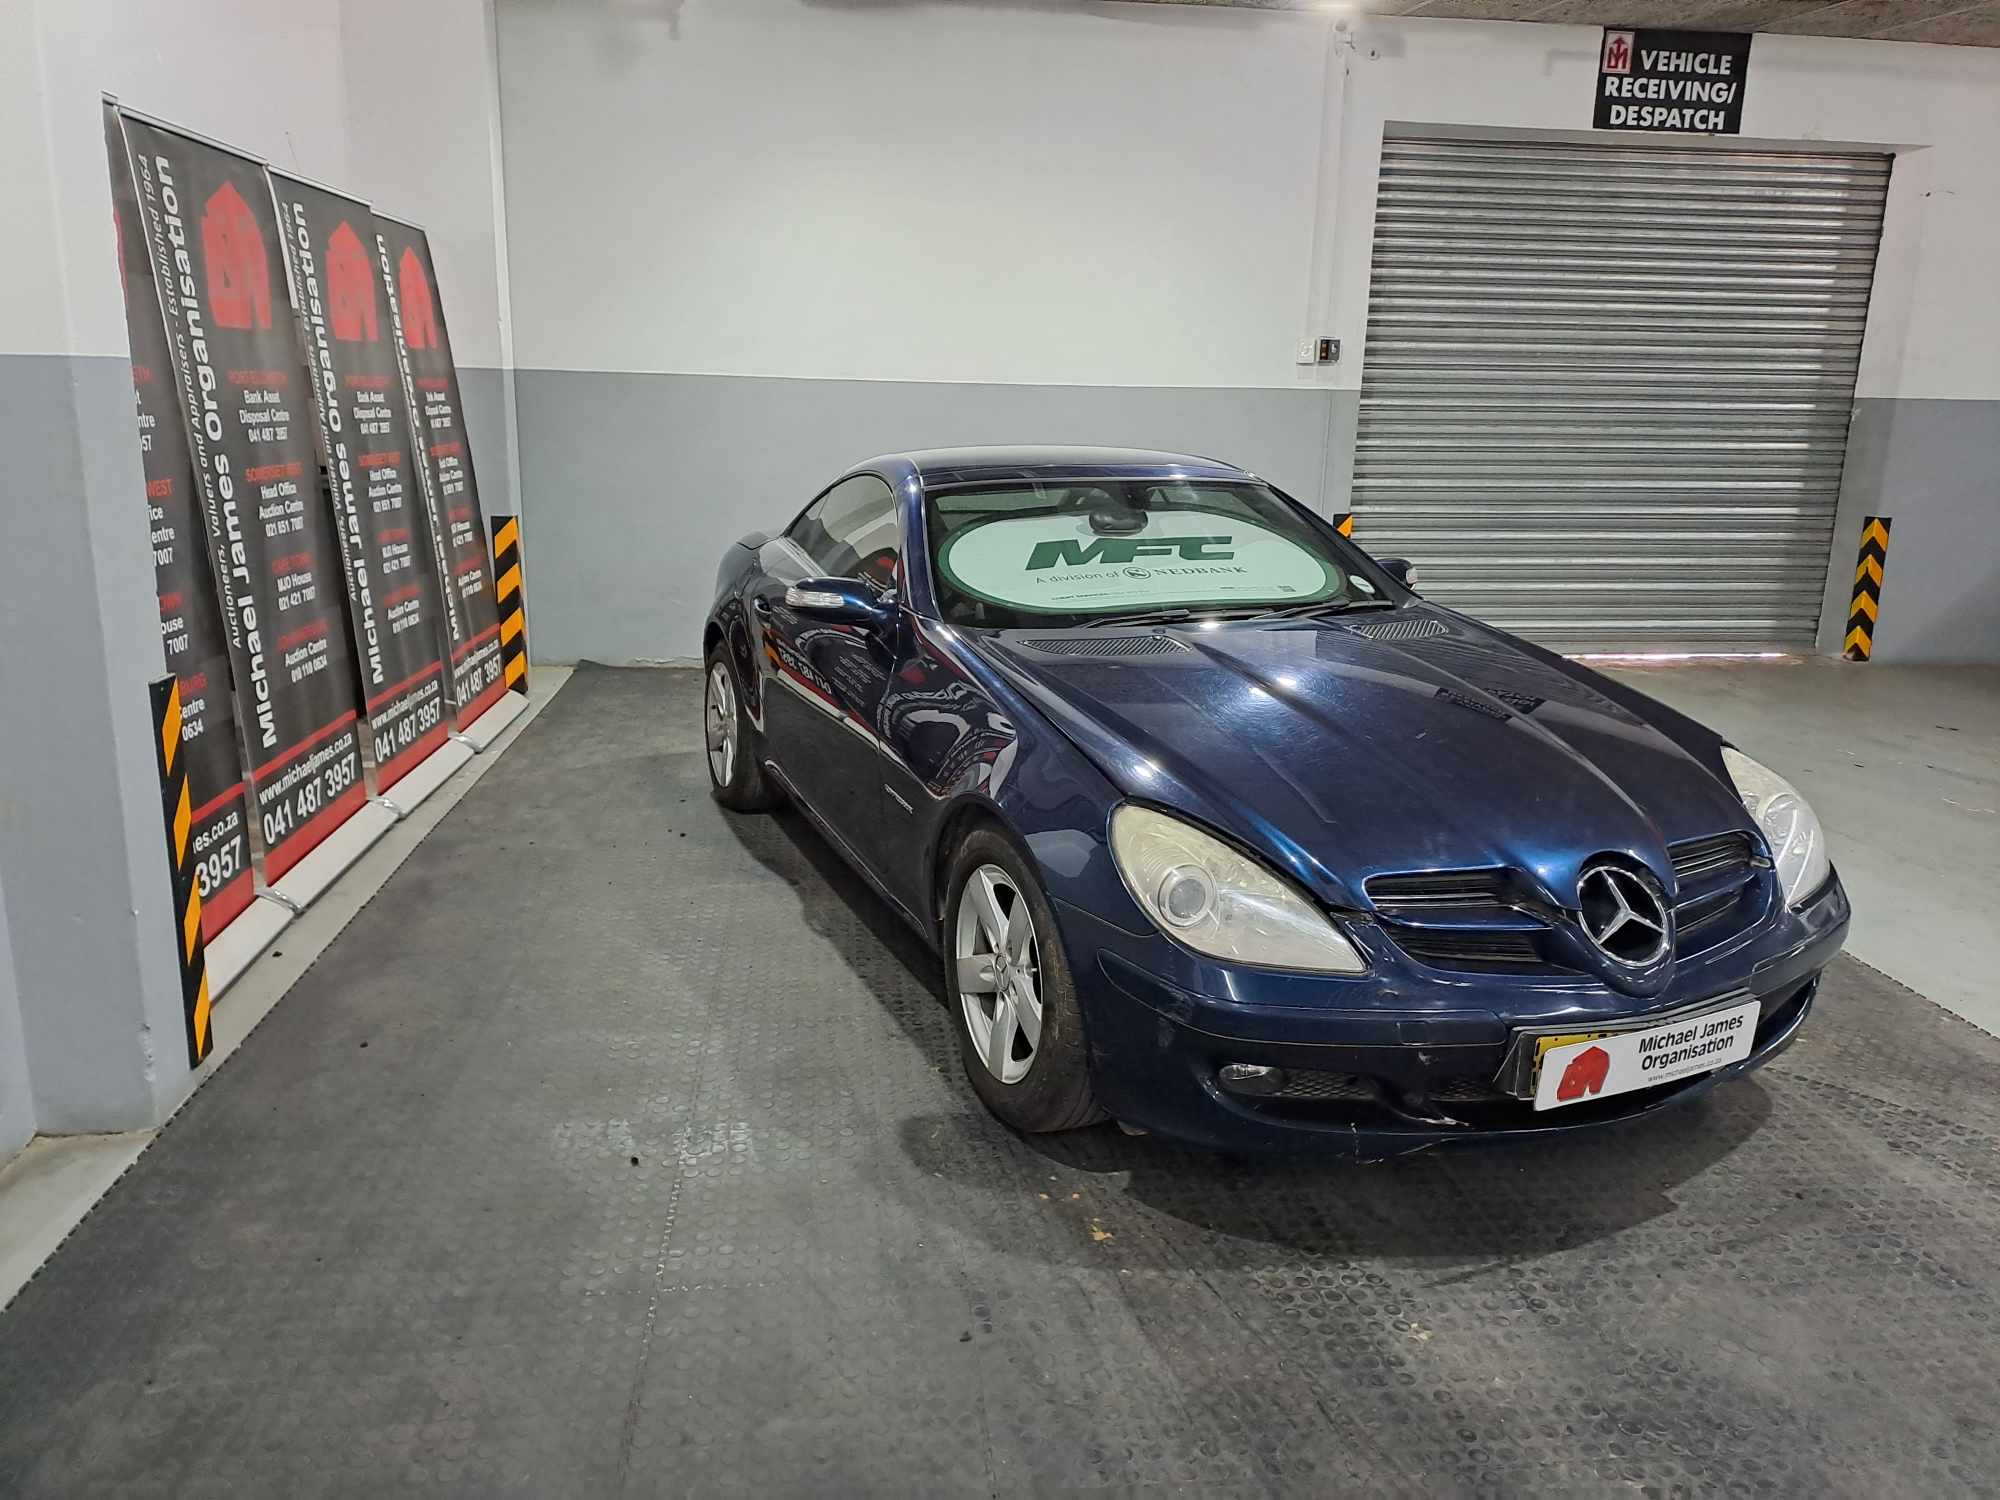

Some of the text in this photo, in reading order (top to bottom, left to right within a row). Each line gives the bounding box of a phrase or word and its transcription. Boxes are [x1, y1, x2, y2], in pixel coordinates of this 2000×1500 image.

[1641, 50, 1732, 75] VEHICLE
[1605, 76, 1737, 104] RECEIVING/
[1610, 105, 1725, 130] DESPATCH
[138, 154, 156, 201] 1964
[148, 206, 178, 316] Established
[293, 203, 341, 433] Organisation
[176, 333, 202, 429] Appraisers
[155, 156, 277, 749] Michael James Organisation
[193, 433, 208, 468] and
[203, 472, 221, 537] Valuers
[335, 443, 362, 549] James
[151, 527, 175, 543] entre
[1025, 536, 1234, 570] MFC
[1049, 573, 1103, 583] division
[1105, 570, 1120, 579] of
[1154, 566, 1248, 577] NEDBANK
[161, 617, 184, 634] ouse
[167, 634, 188, 655] 7007
[354, 558, 384, 685] Michael
[456, 653, 501, 707] 041 487 3957
[182, 718, 204, 741] 0634
[374, 696, 440, 762] 041 487 3957
[259, 732, 352, 805] www.michaeljames.co.za
[263, 752, 355, 844] 041 487 3957
[196, 835, 241, 897] 3957
[1639, 1015, 1744, 1054] Michael James
[1641, 1035, 1734, 1071] Organisation
